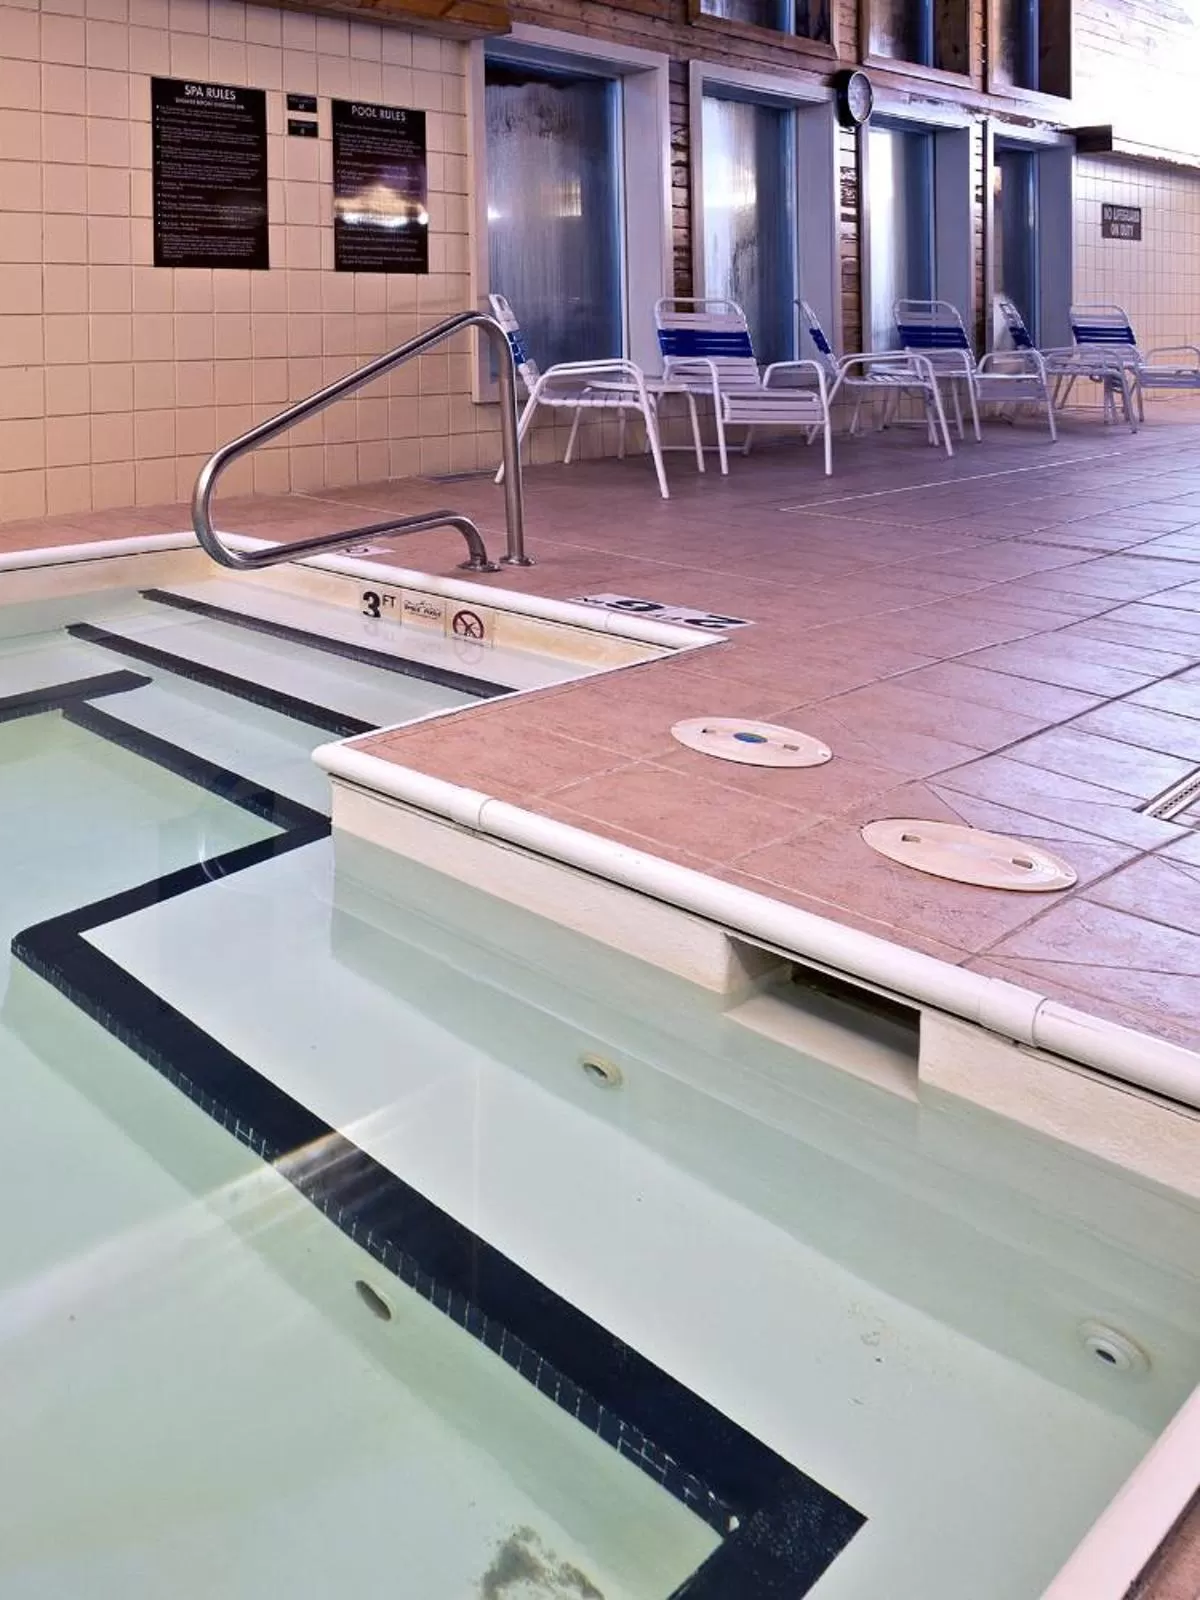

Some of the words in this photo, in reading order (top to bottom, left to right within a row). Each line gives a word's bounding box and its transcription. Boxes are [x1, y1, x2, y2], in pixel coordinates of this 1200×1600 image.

[184, 84, 204, 98] SPA
[206, 86, 237, 101] RULES
[351, 104, 378, 119] POOL
[379, 108, 406, 122] RULES
[362, 591, 381, 618] 3
[382, 594, 397, 608] FT
